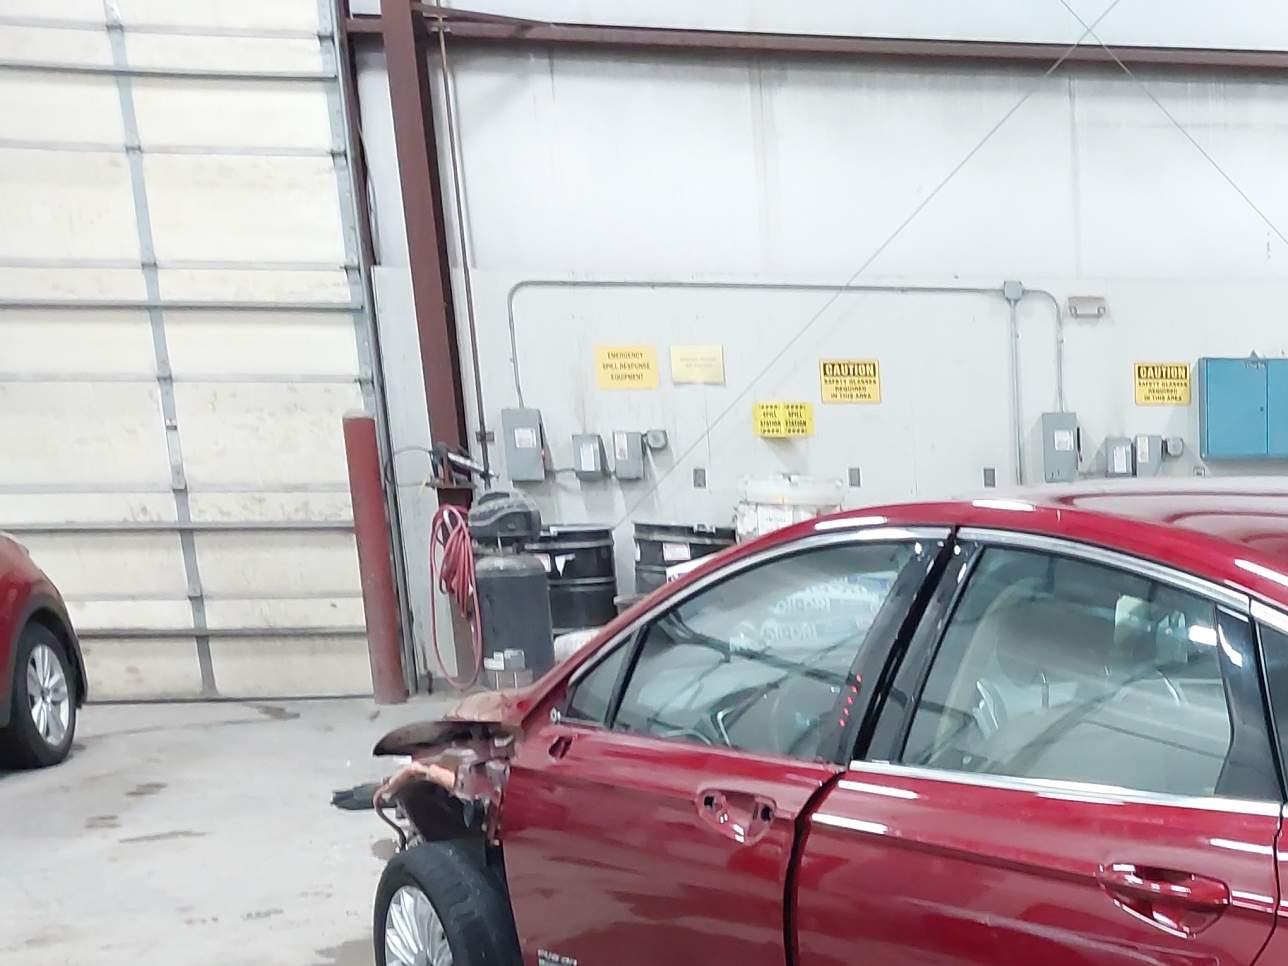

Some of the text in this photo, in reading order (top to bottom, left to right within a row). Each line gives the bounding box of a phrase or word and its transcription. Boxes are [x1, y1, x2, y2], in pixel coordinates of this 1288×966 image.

[602, 362, 650, 370] SPILL RESPONSE
[825, 363, 874, 376] CAUTION
[1140, 366, 1185, 379] CAUTION
